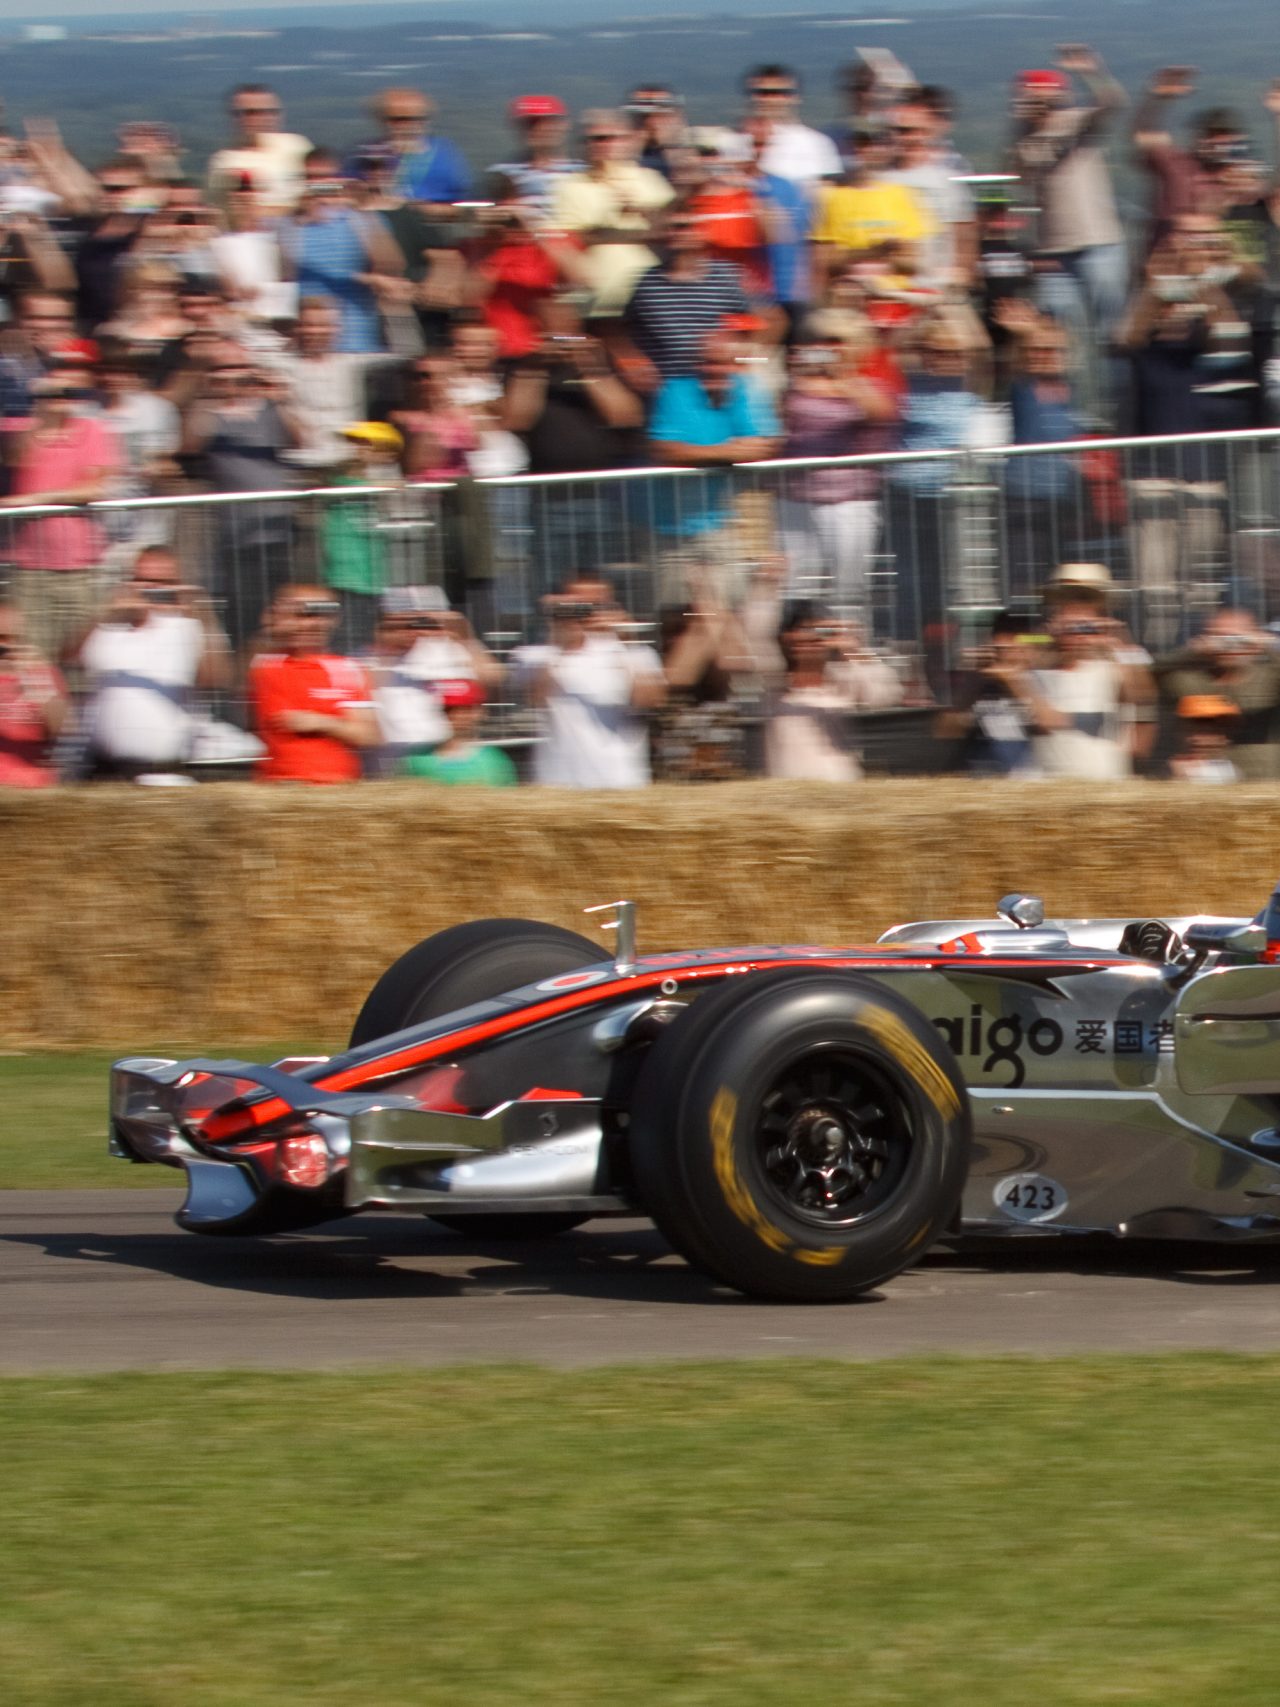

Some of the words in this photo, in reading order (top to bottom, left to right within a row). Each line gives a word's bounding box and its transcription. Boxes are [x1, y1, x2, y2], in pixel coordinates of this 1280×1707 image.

[930, 1003, 1064, 1089] aigo
[1074, 1018, 1176, 1055] 爱国者
[1005, 1183, 1055, 1210] 423
